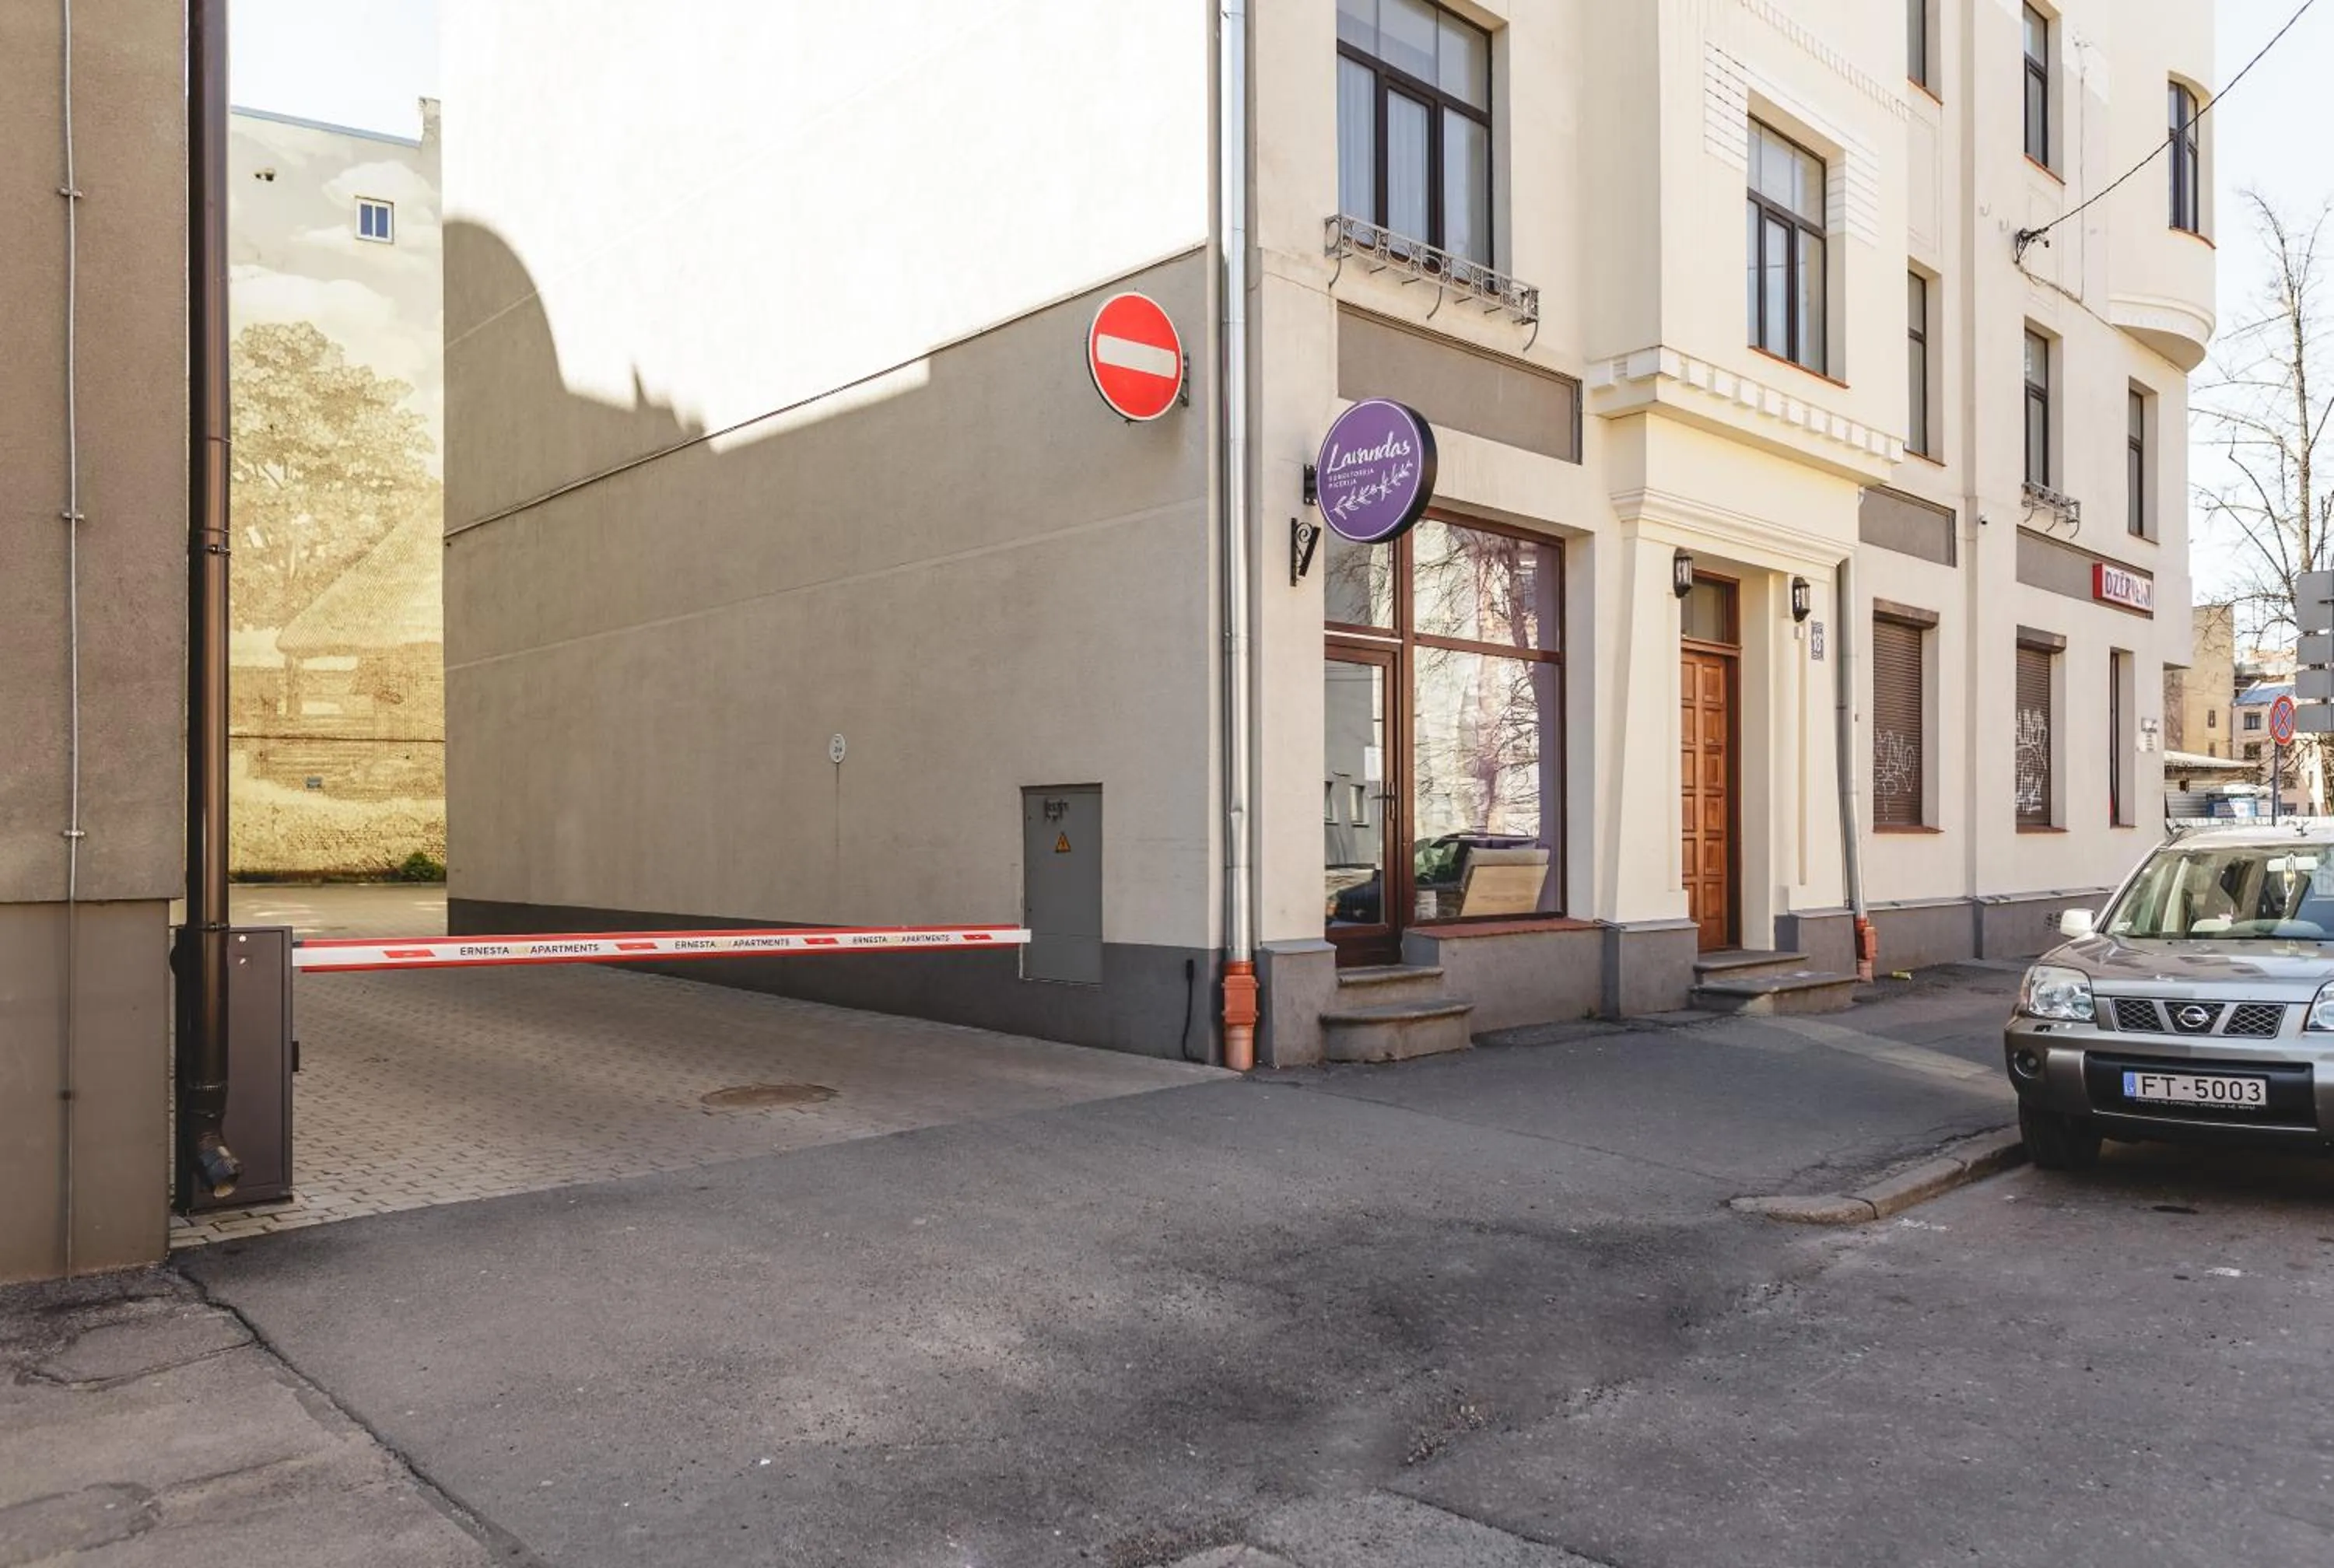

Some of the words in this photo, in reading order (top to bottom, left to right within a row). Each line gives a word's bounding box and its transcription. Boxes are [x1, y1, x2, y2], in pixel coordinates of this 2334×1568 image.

[674, 940, 717, 950] ERNESTA
[733, 937, 790, 947] APARTMENTS
[852, 936, 888, 944] ERNESTA
[902, 934, 950, 943] APARTMENTS
[460, 946, 510, 956] ERNESTA
[530, 943, 599, 954] APARTMENTS
[2141, 1076, 2261, 1102] FT-5003
